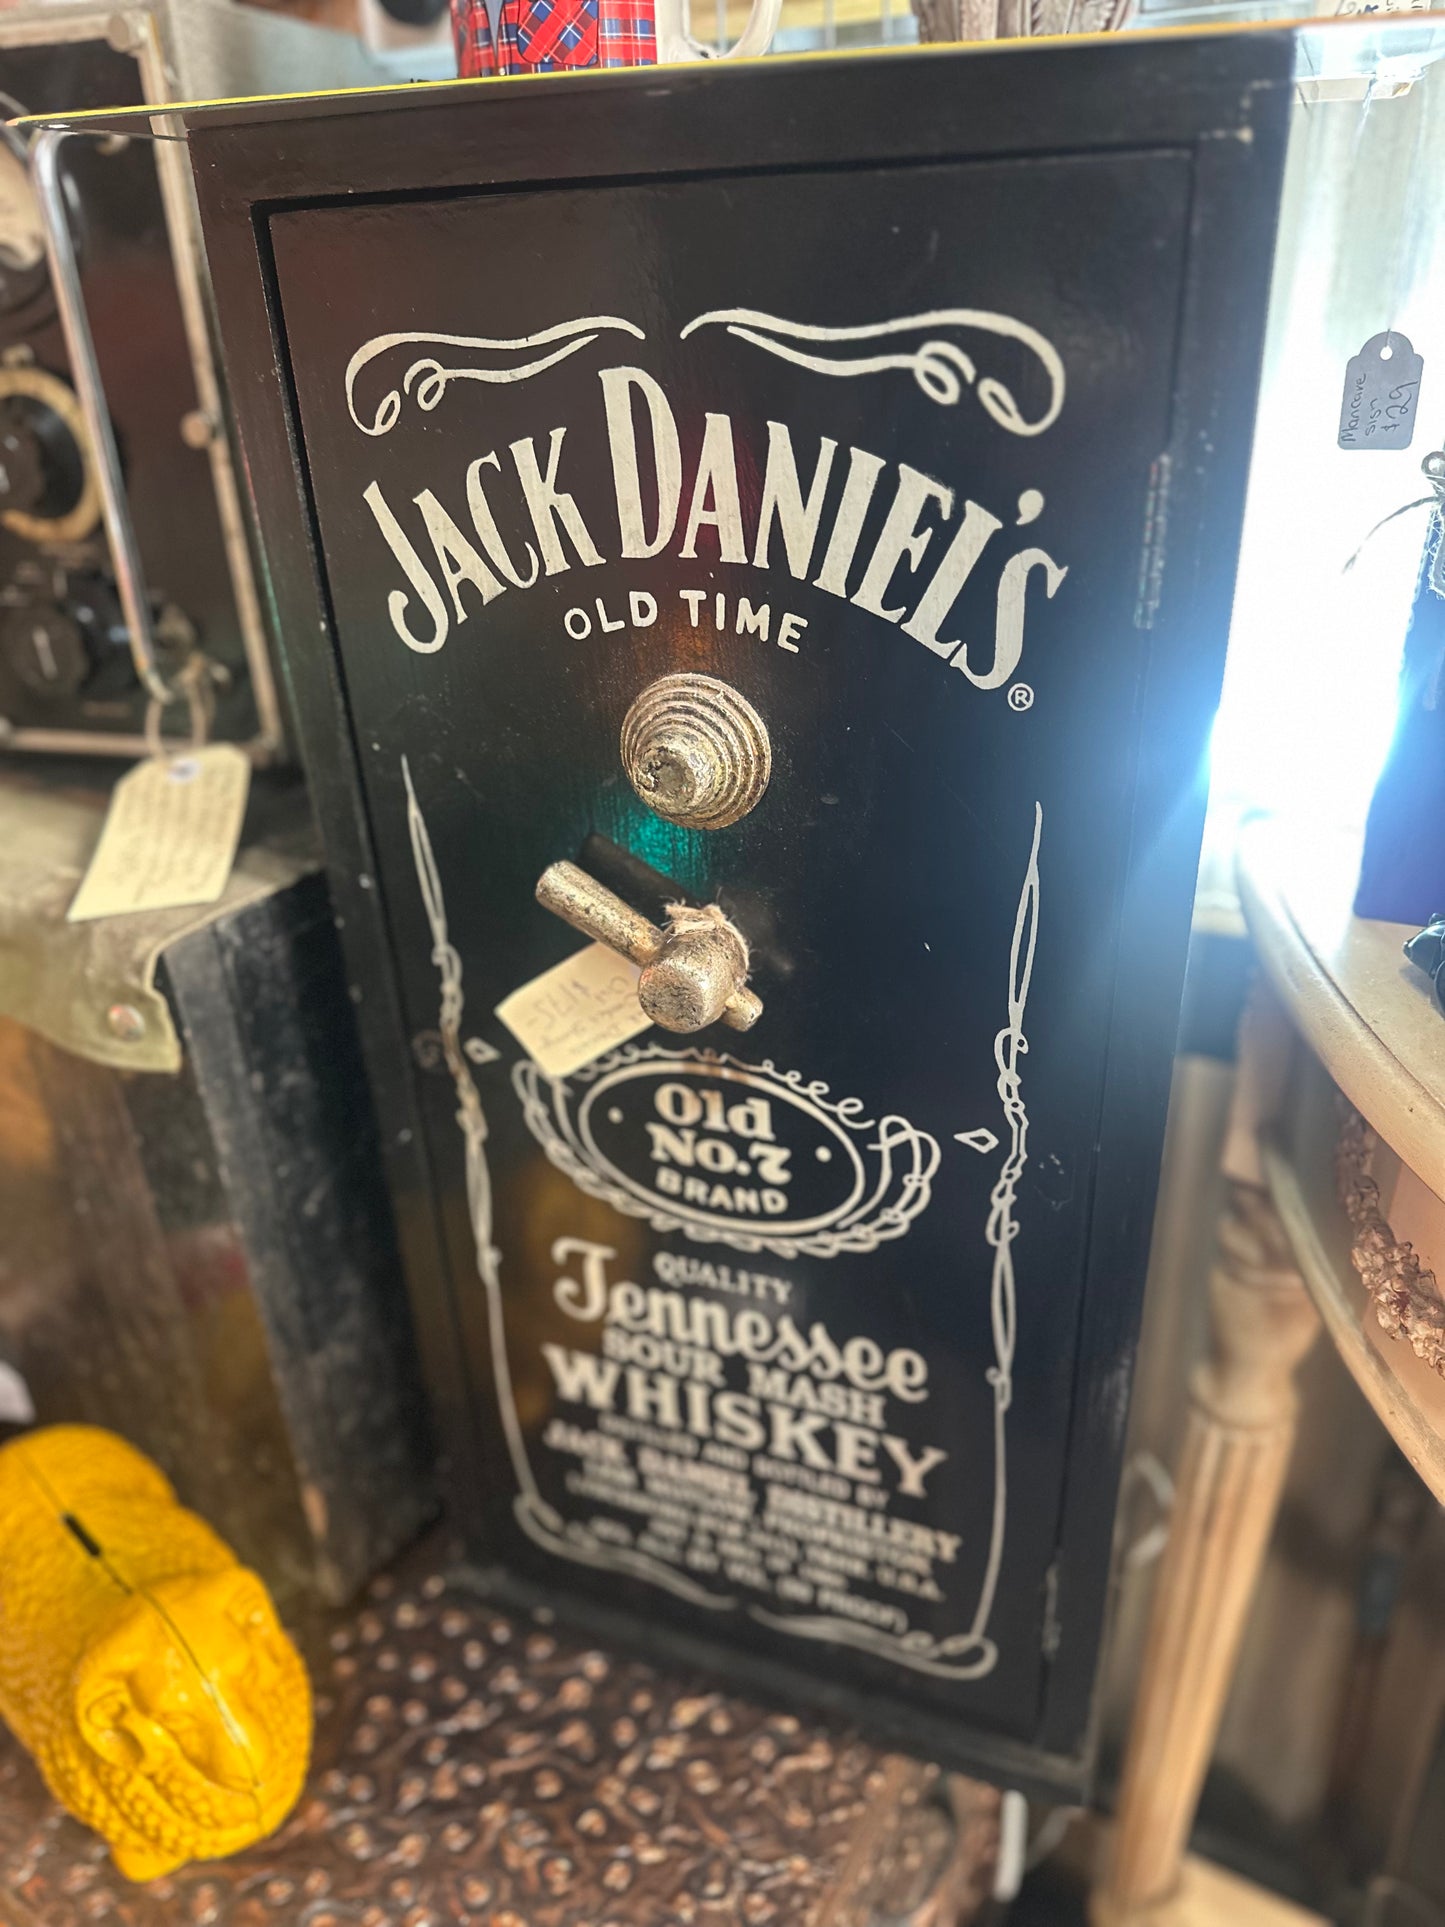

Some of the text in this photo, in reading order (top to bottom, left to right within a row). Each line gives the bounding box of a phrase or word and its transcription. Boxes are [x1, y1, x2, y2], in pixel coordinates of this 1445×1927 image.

[1340, 373, 1366, 442] Mancave
[1380, 380, 1419, 432] $29
[362, 365, 1068, 691] JACK DANIEL'S
[564, 589, 809, 654] OLD TIME
[653, 1082, 776, 1141] Old
[655, 1166, 788, 1215] BRAND
[653, 1251, 793, 1304] QUALITY
[551, 1236, 929, 1402] Tennessee
[601, 1326, 887, 1429] SOUR MASH
[542, 1343, 947, 1497] WHISKEY
